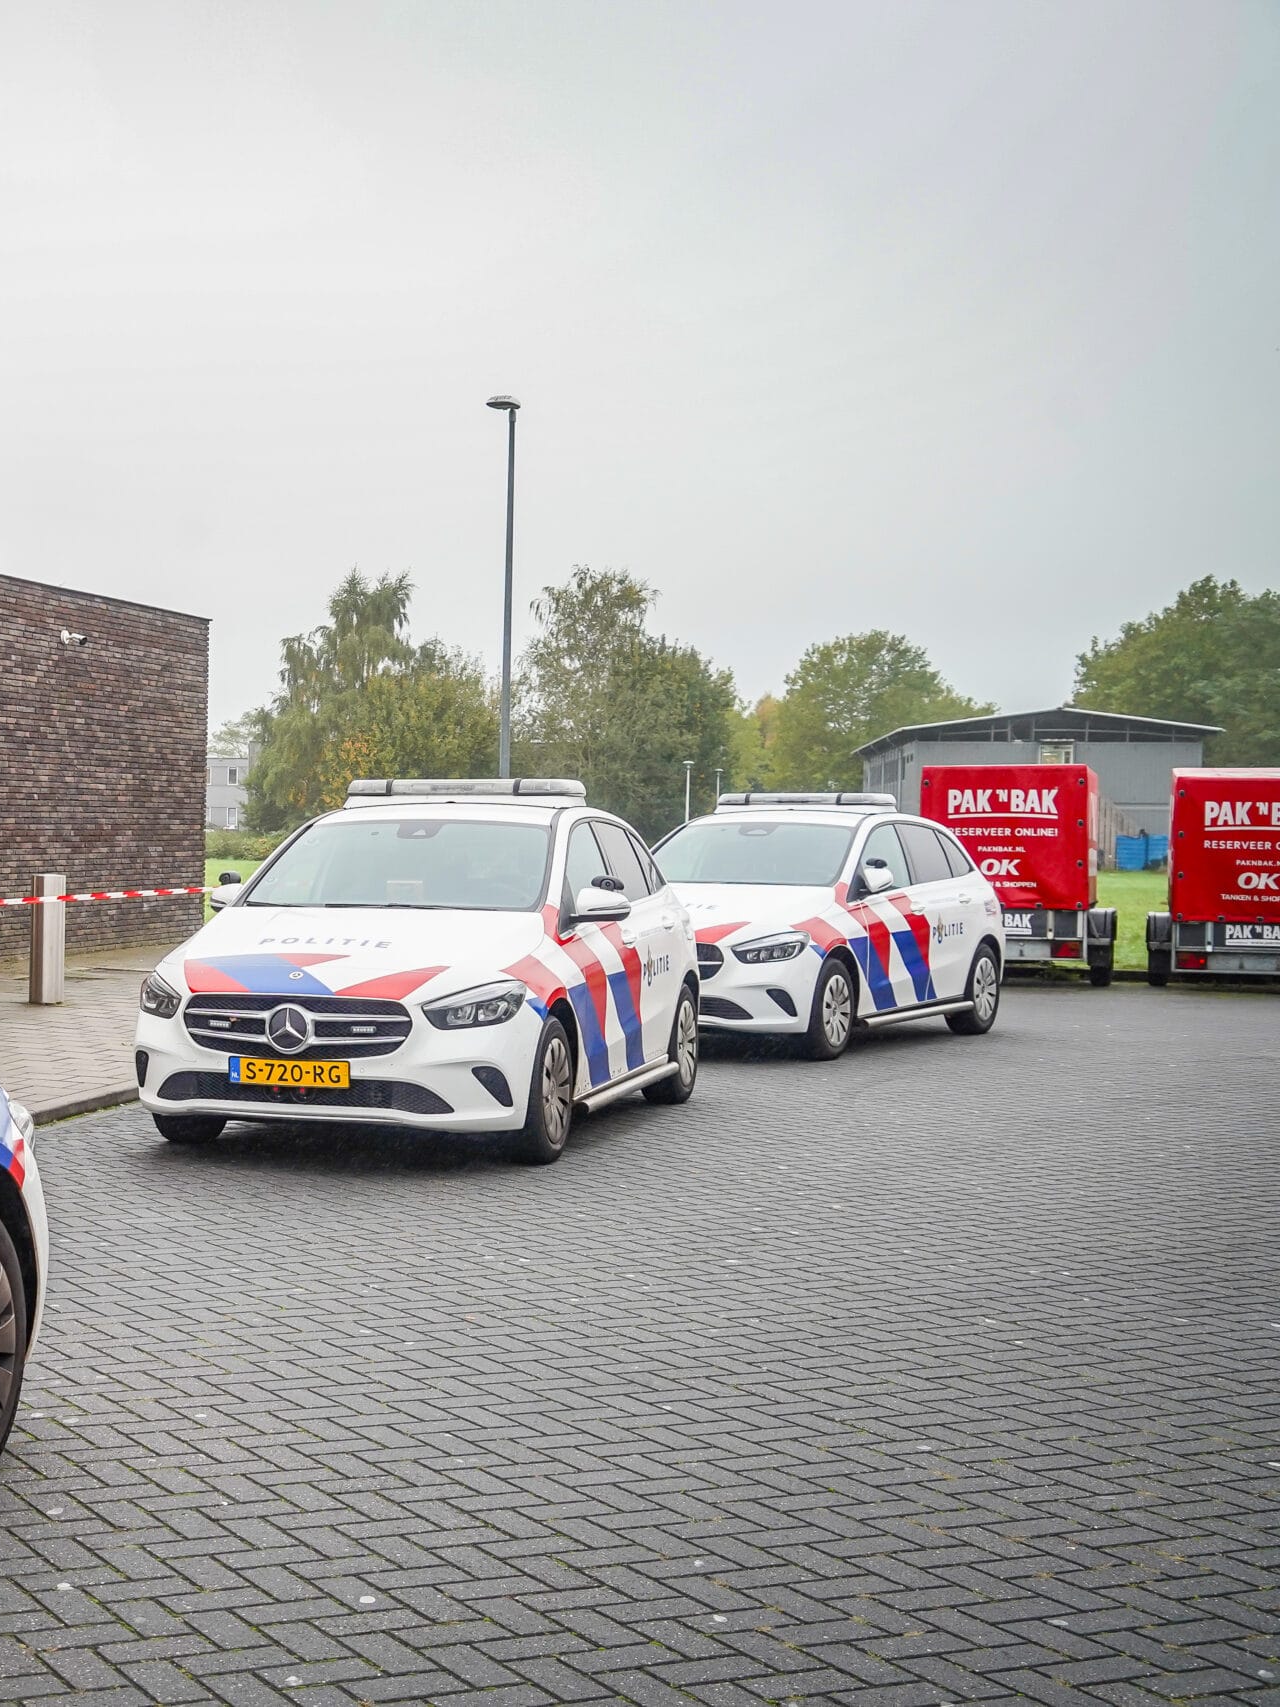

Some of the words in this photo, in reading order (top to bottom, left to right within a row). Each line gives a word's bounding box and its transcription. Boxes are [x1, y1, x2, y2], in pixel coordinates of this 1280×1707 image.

[948, 789, 993, 814] PAK
[1010, 788, 1058, 815] BAK
[1204, 801, 1253, 826] PAK
[949, 827, 1011, 837] RESERVEER
[1014, 827, 1059, 837] ONLINE!
[977, 845, 1026, 853] PAKNBAK.NL
[1203, 840, 1272, 850] RESERVEER
[980, 858, 1021, 875] OK
[1237, 872, 1280, 890] OK
[1220, 893, 1252, 901] TANKEN
[1004, 913, 1032, 928] BAK
[932, 921, 964, 944] POLITIE
[1225, 924, 1253, 939] PAK
[258, 936, 393, 949] POLITIE
[245, 1062, 341, 1084] S-720-RG
